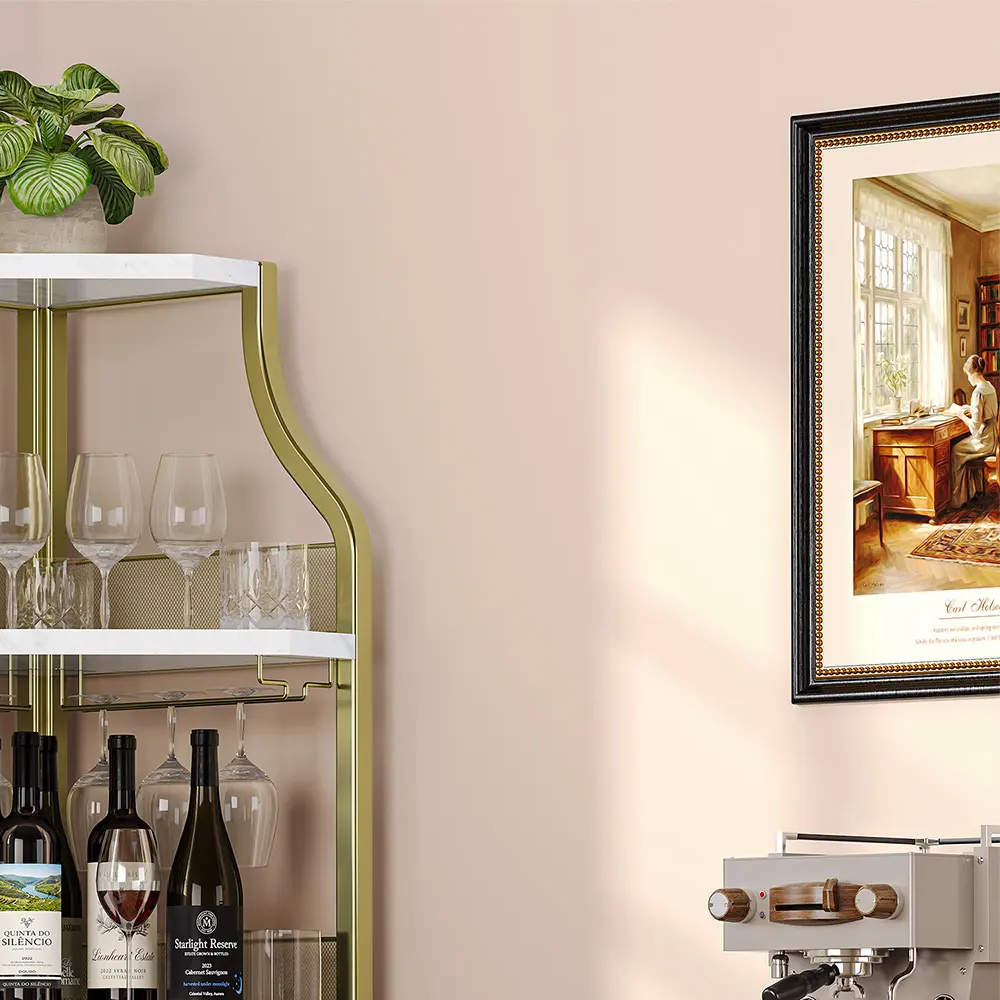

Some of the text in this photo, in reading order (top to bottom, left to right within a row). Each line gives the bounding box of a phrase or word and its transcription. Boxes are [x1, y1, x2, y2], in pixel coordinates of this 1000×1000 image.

[945, 599, 967, 614] Carl
[3, 930, 36, 938] QUINTA
[1, 936, 53, 946] SILÊNCIO
[174, 938, 238, 952] Starlight Reserve
[184, 968, 229, 977] Cabernet Sauvignon
